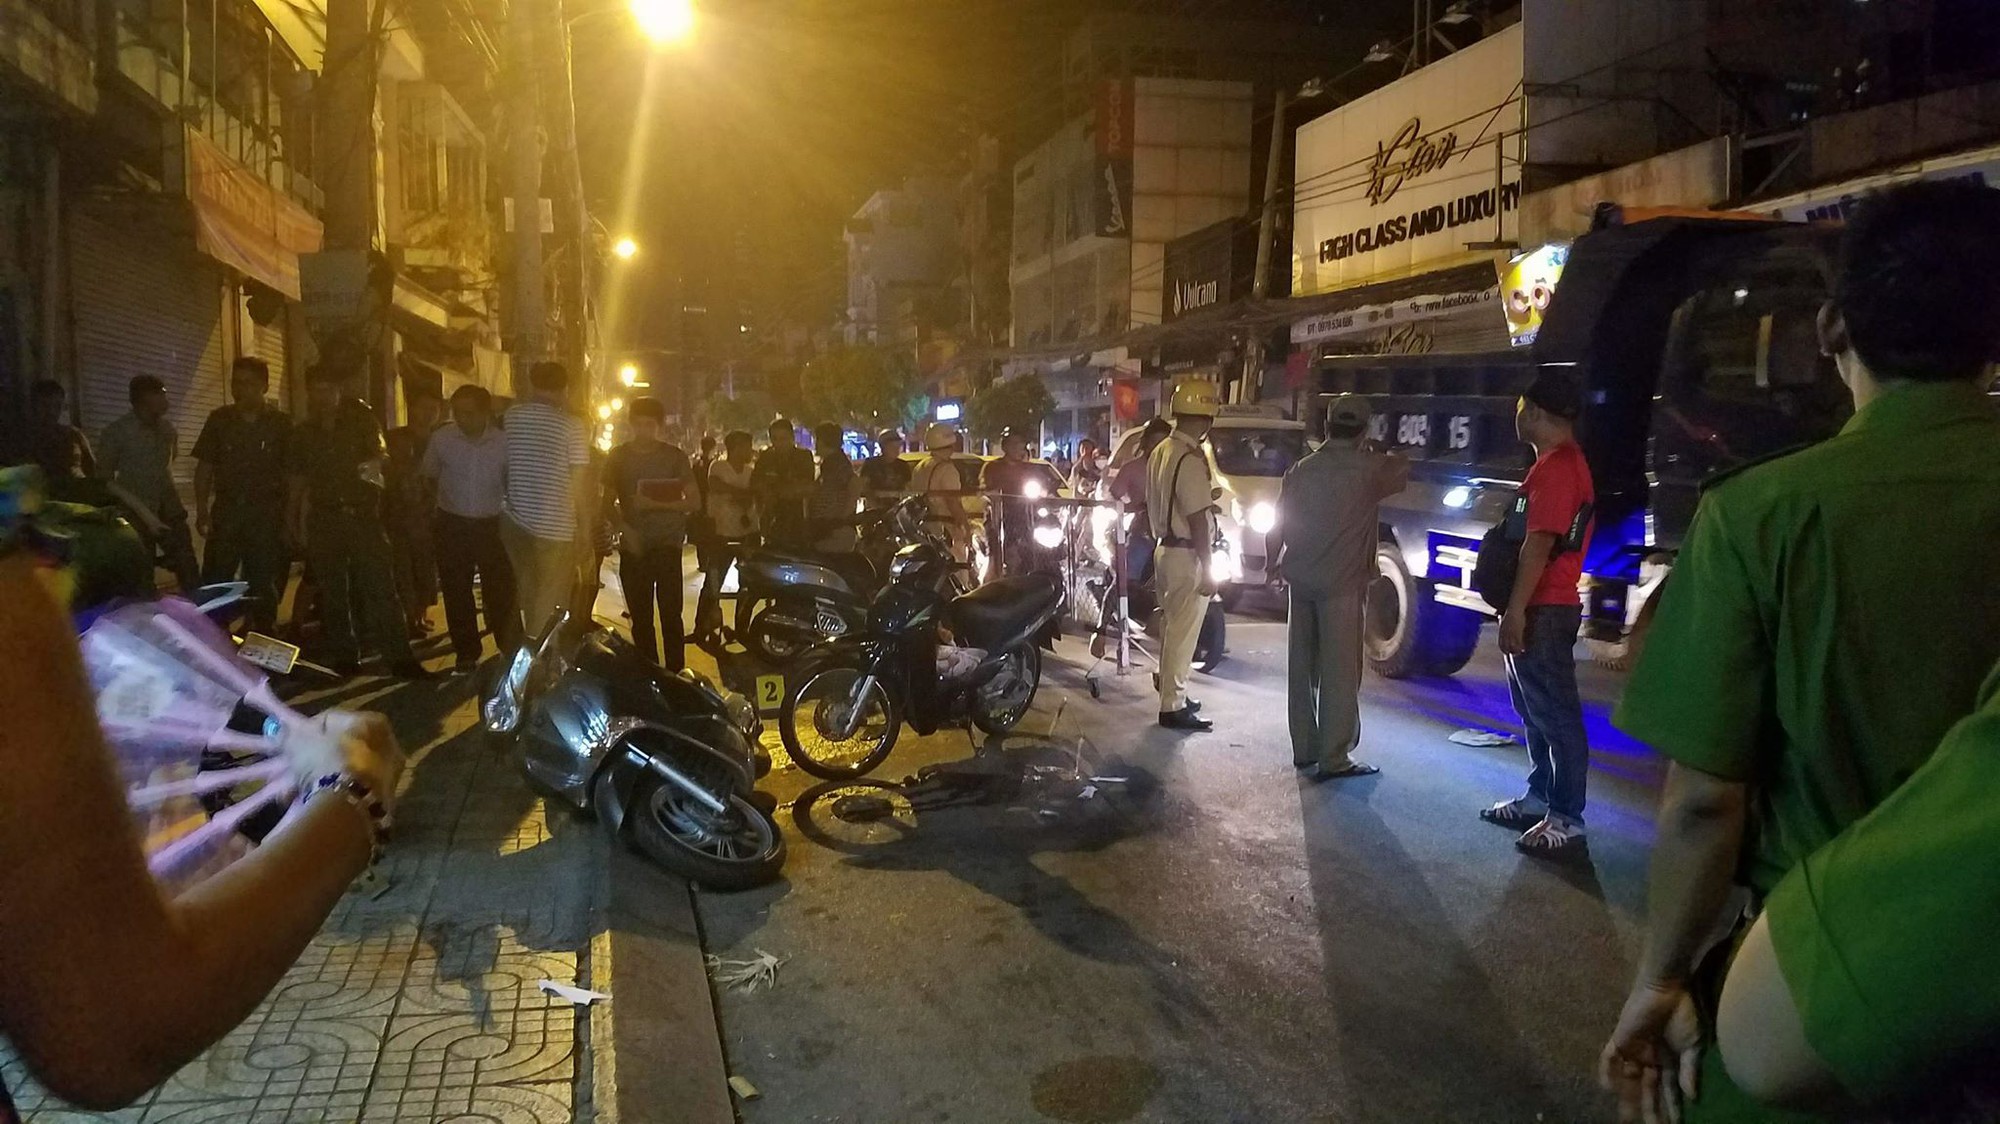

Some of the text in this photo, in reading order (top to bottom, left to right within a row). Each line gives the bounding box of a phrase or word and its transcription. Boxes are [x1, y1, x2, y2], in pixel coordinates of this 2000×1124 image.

[1319, 181, 1521, 263] HIGH CLASS AND LUXURY
[1448, 415, 1470, 449] 15
[764, 681, 778, 702] 2
